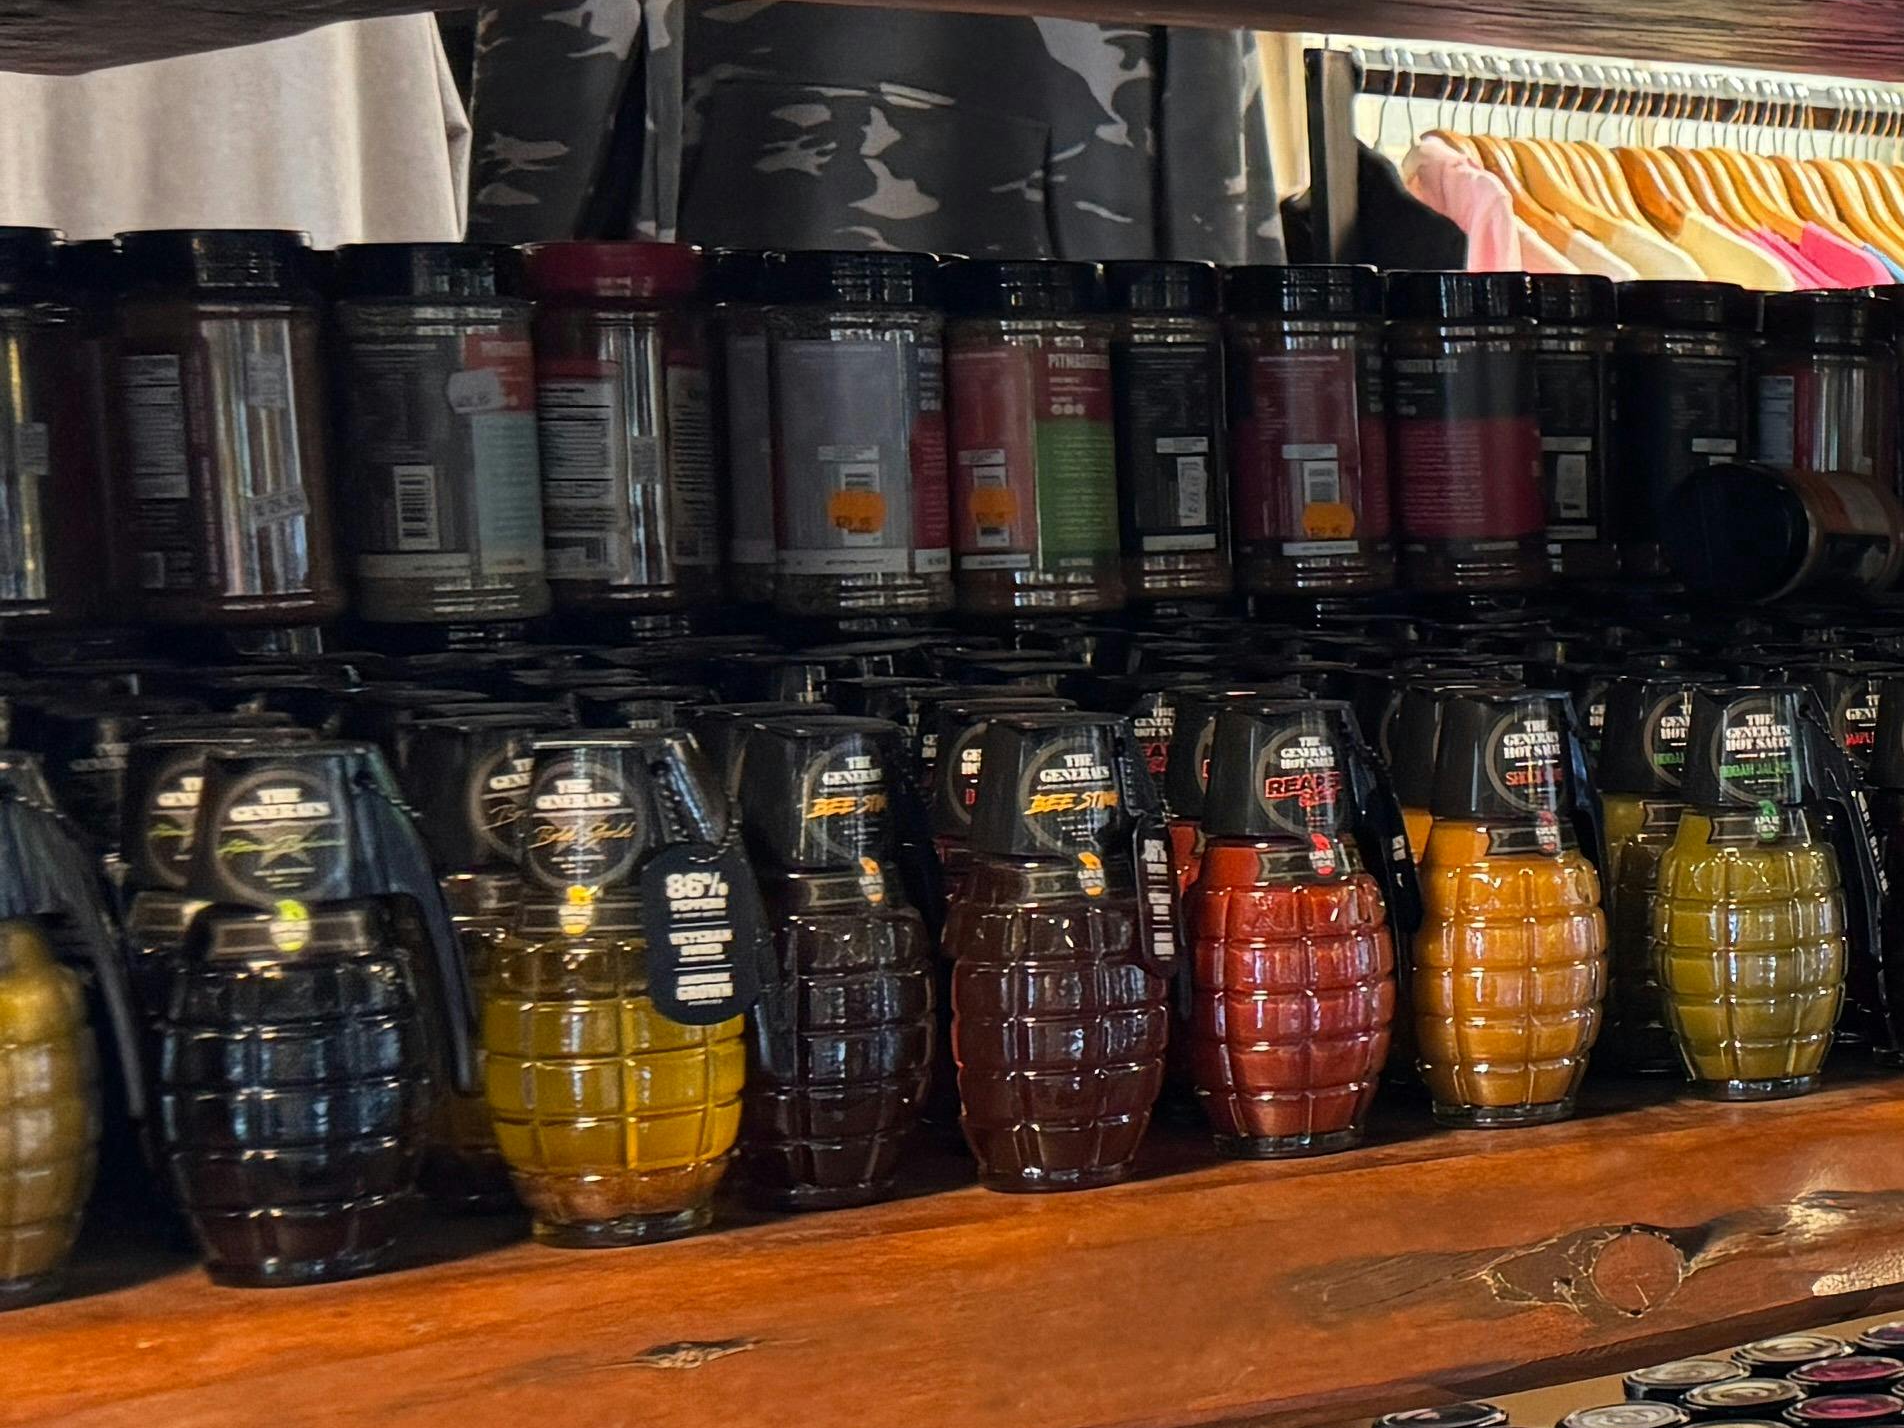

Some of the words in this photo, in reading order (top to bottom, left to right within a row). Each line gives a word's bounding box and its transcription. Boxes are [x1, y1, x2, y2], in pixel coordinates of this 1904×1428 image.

[1745, 713, 1776, 728] THE
[1064, 754, 1094, 769] THE
[1024, 793, 1077, 816] BEE
[664, 872, 729, 899] 86%
